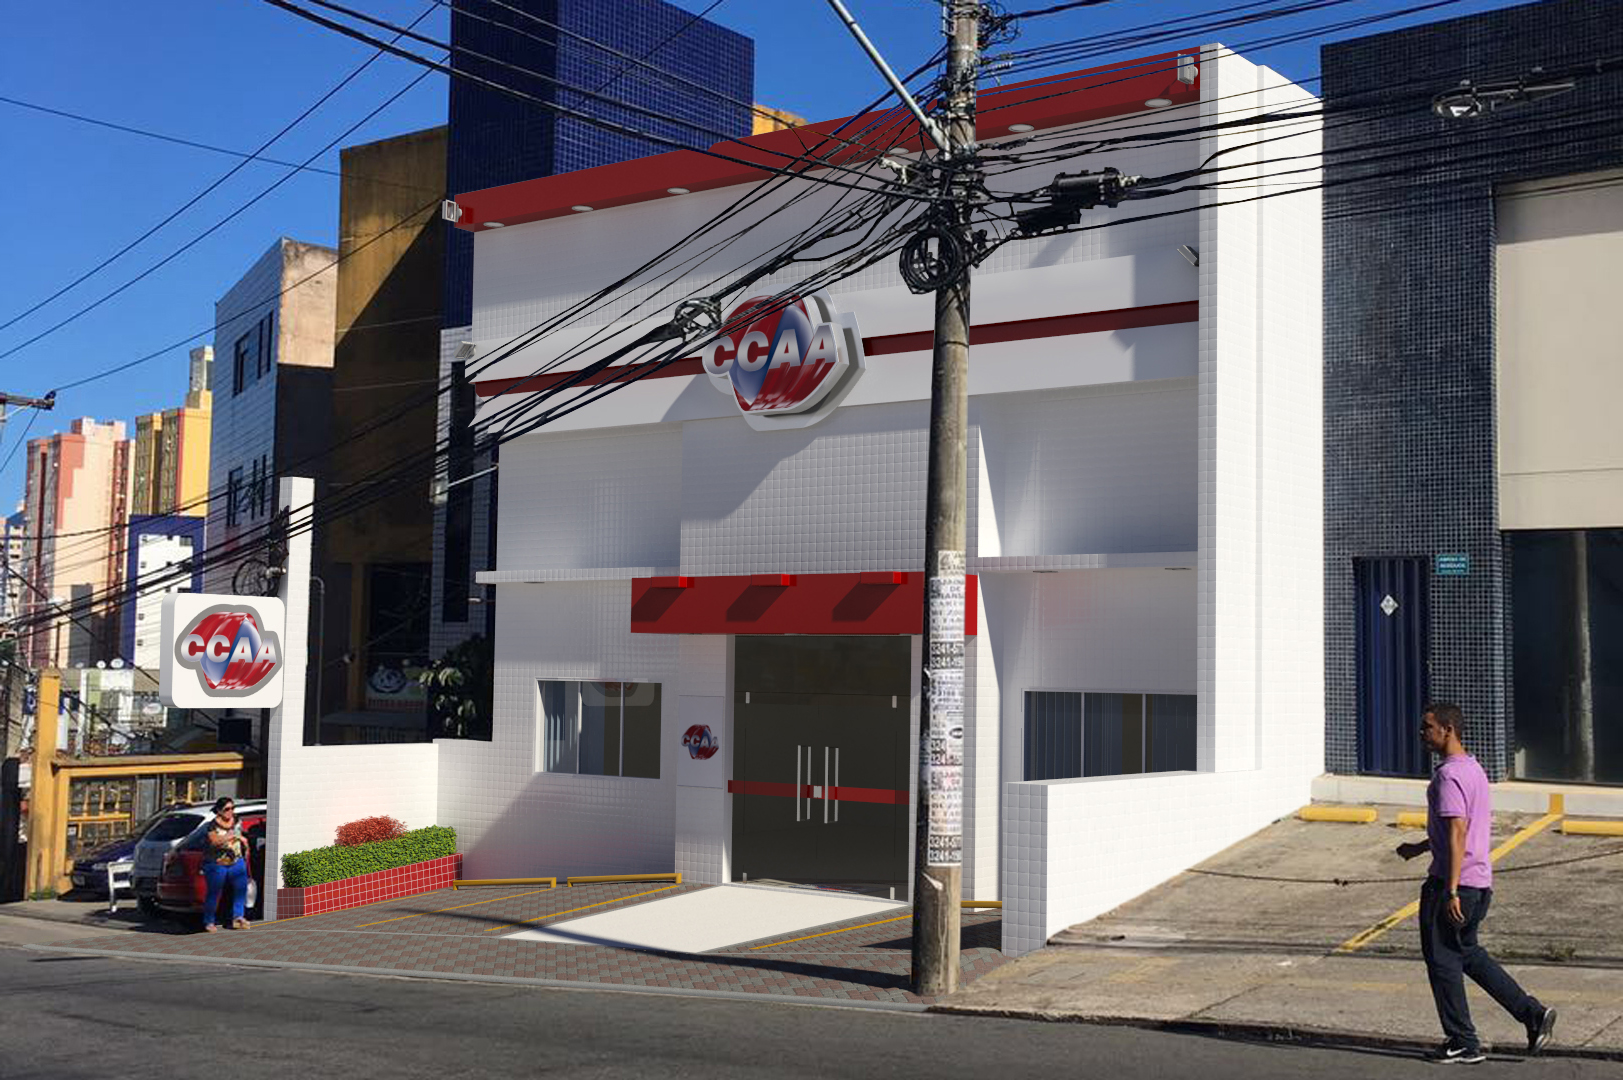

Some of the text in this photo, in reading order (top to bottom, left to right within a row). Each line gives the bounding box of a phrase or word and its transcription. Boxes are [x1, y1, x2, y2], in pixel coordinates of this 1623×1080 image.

[704, 325, 837, 374] CCAA
[181, 633, 277, 663] CCAA
[681, 734, 719, 748] CCAA
